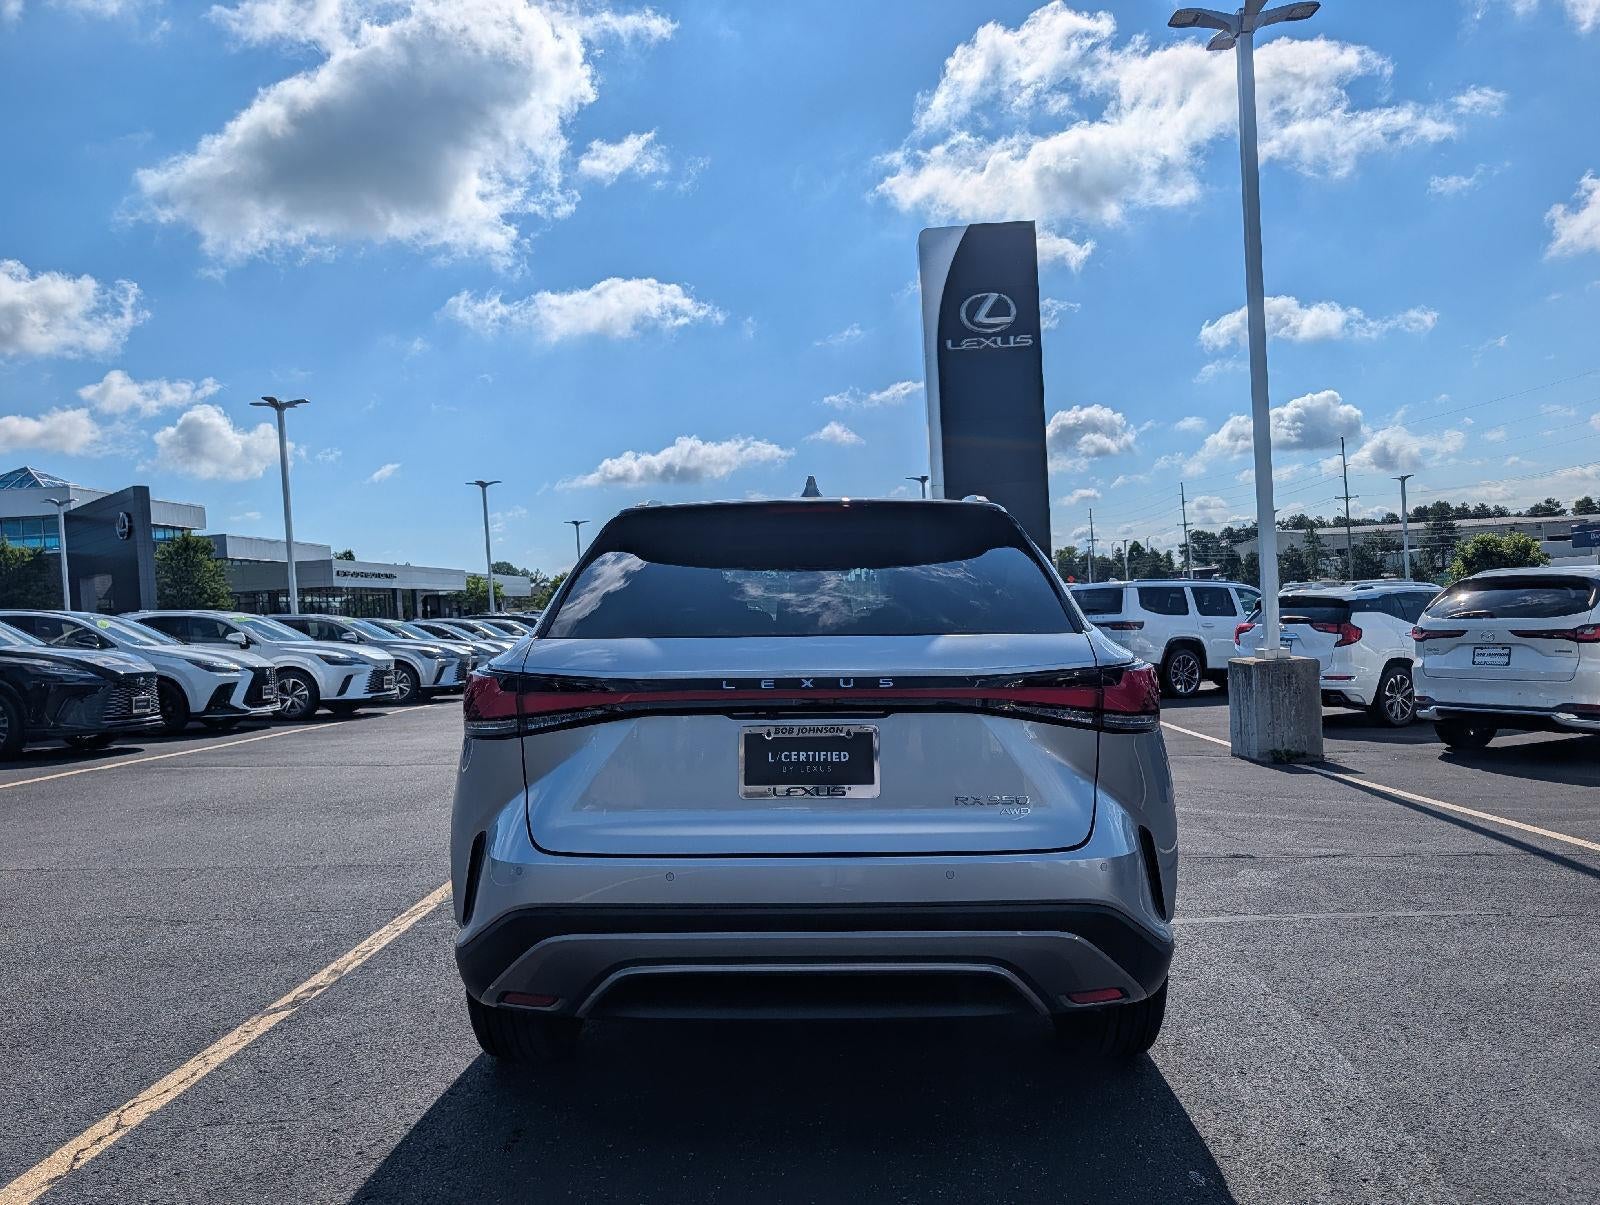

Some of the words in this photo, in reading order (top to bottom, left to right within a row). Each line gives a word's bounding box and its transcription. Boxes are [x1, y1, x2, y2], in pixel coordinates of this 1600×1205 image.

[946, 334, 1034, 350] LEXUS
[722, 678, 894, 689] LEXUS
[774, 726, 795, 735] BOB
[796, 726, 844, 736] JOHNSON
[782, 765, 794, 773] BY
[800, 765, 832, 773] LEXUS
[772, 786, 848, 797] LEXUS
[1000, 807, 1031, 815] AWD
